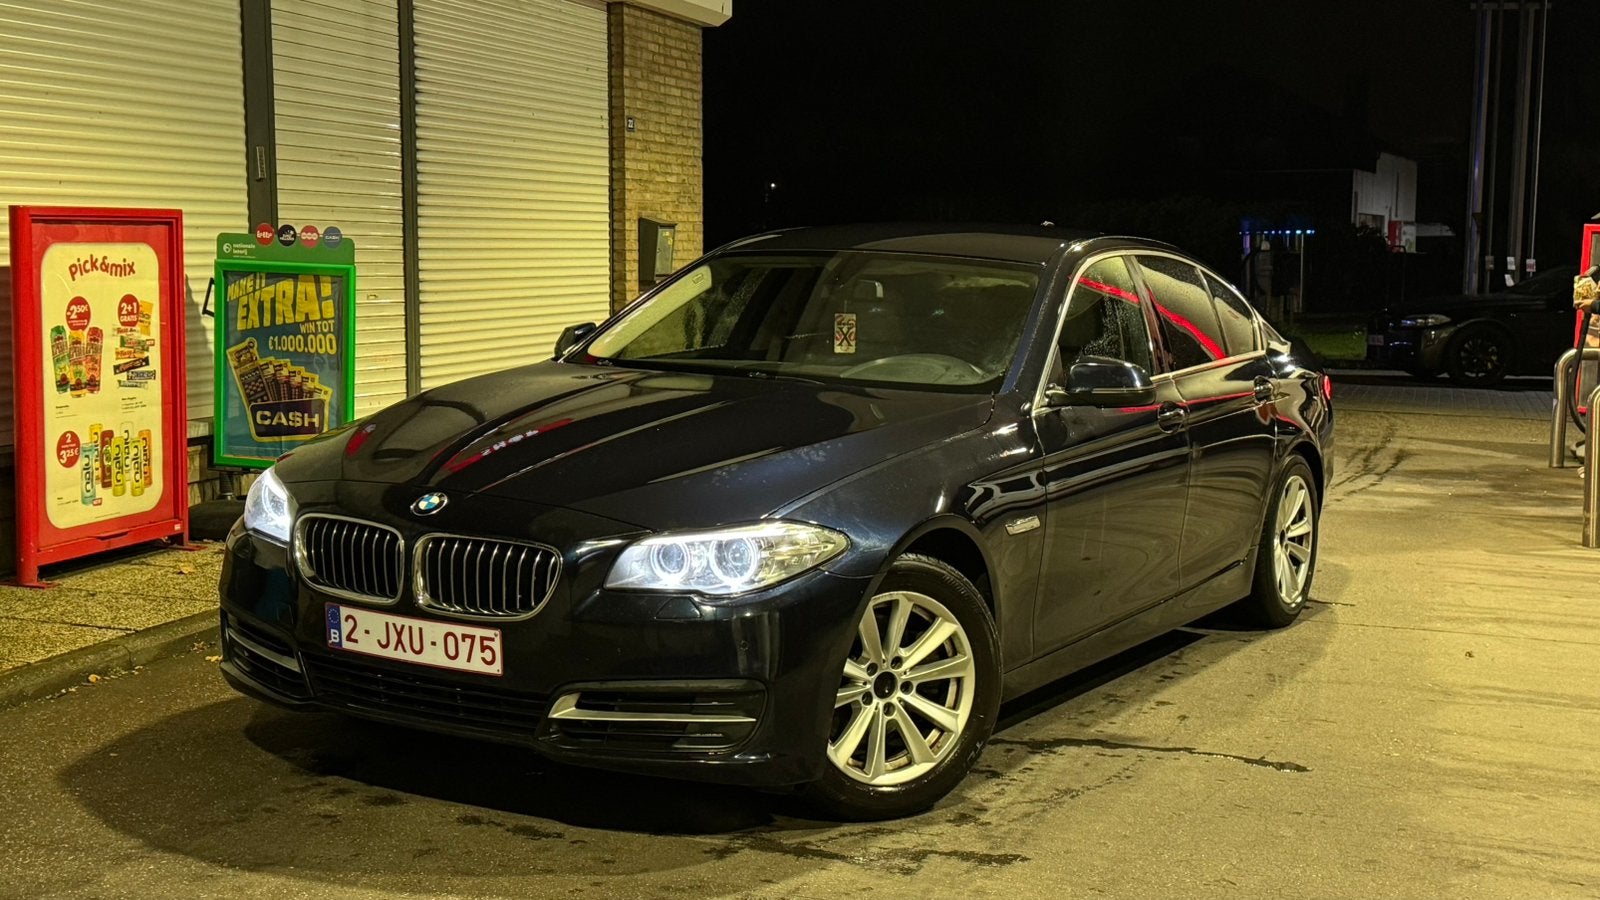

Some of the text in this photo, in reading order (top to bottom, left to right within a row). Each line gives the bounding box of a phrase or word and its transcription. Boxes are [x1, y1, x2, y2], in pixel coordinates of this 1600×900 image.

[68, 254, 136, 281] pick&mix
[227, 273, 255, 302] MAKE
[121, 302, 137, 315] 2+1
[237, 274, 335, 331] EXTRA!
[300, 320, 335, 334] WIN TOT
[268, 333, 337, 355] €1.000.000
[65, 433, 72, 443] 2
[330, 629, 340, 643] B
